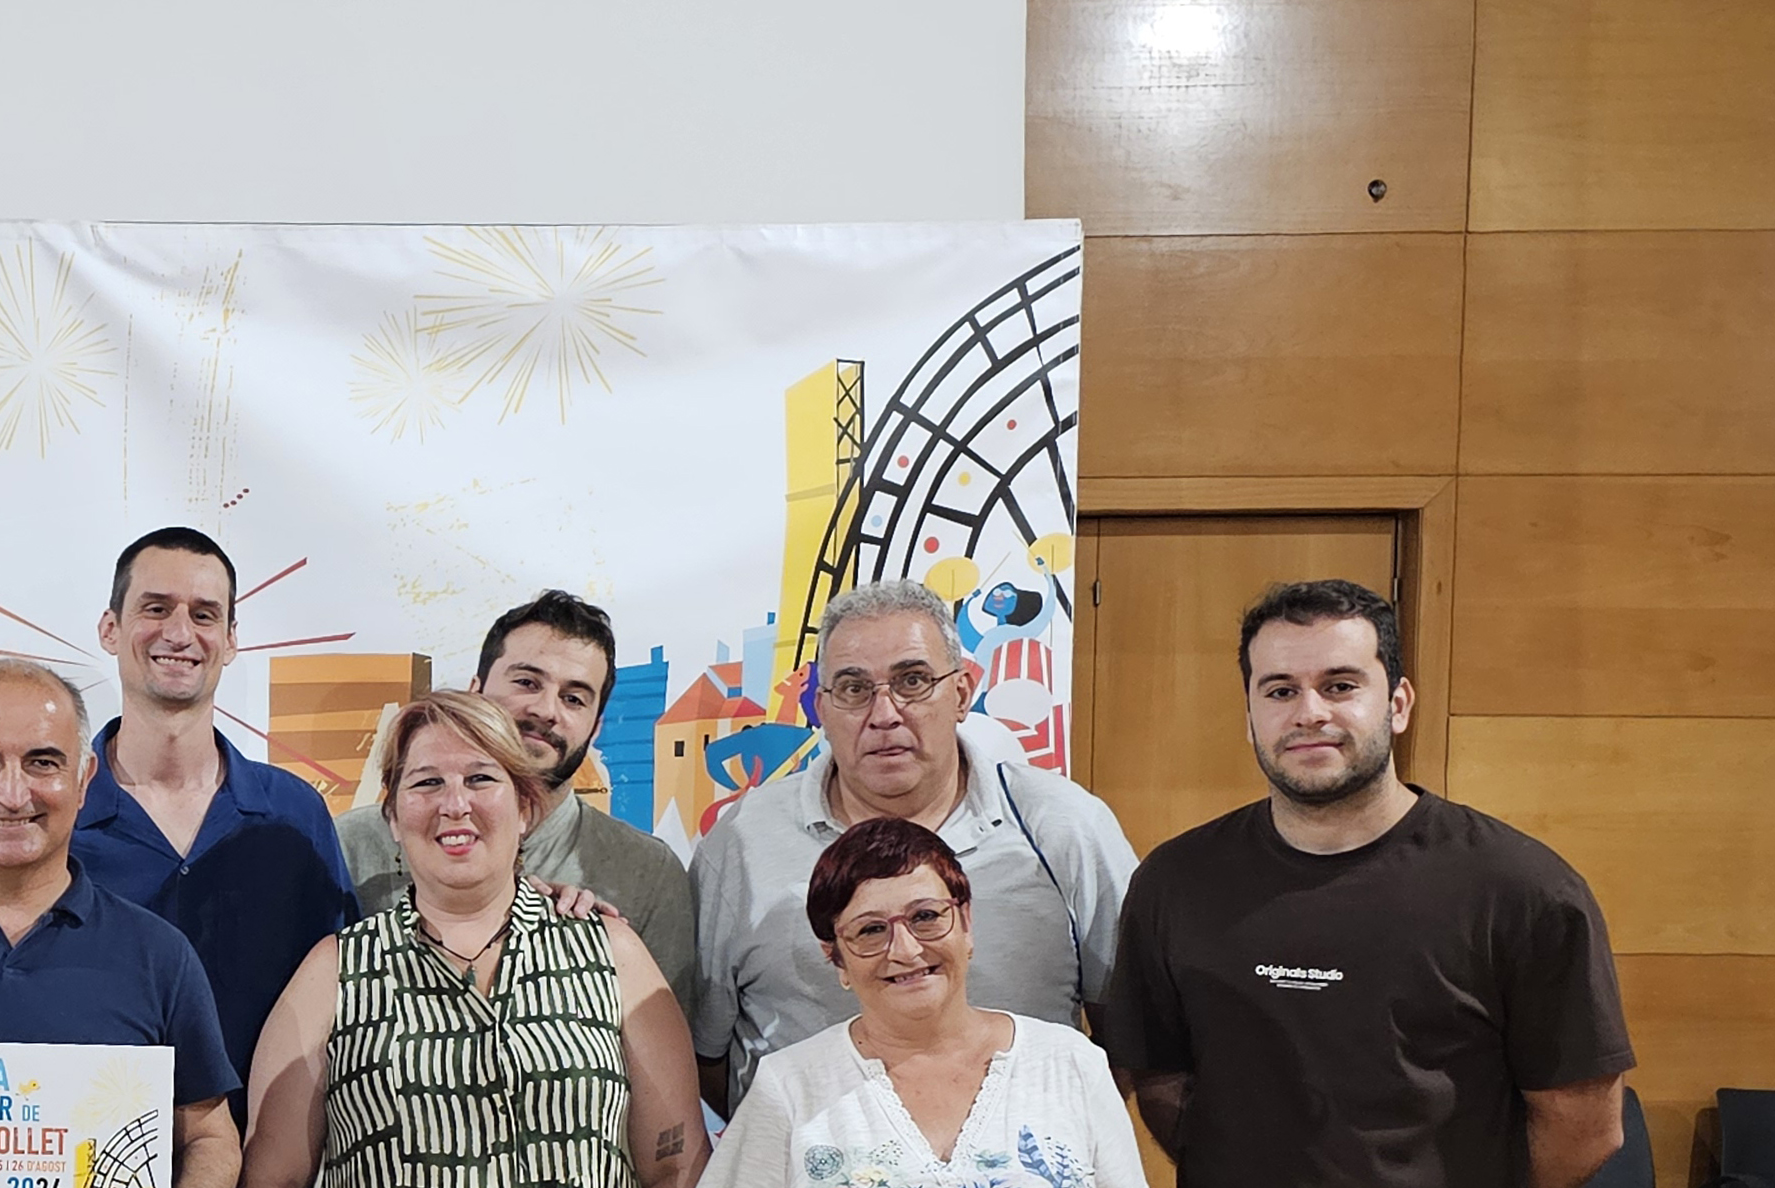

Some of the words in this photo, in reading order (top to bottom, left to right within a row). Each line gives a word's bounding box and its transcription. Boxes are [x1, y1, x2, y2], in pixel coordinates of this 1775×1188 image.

[1255, 965, 1307, 979] Originals
[1308, 968, 1344, 981] Studio
[22, 1104, 40, 1122] DE
[12, 1160, 24, 1171] 26
[27, 1160, 66, 1173] D'AGOST
